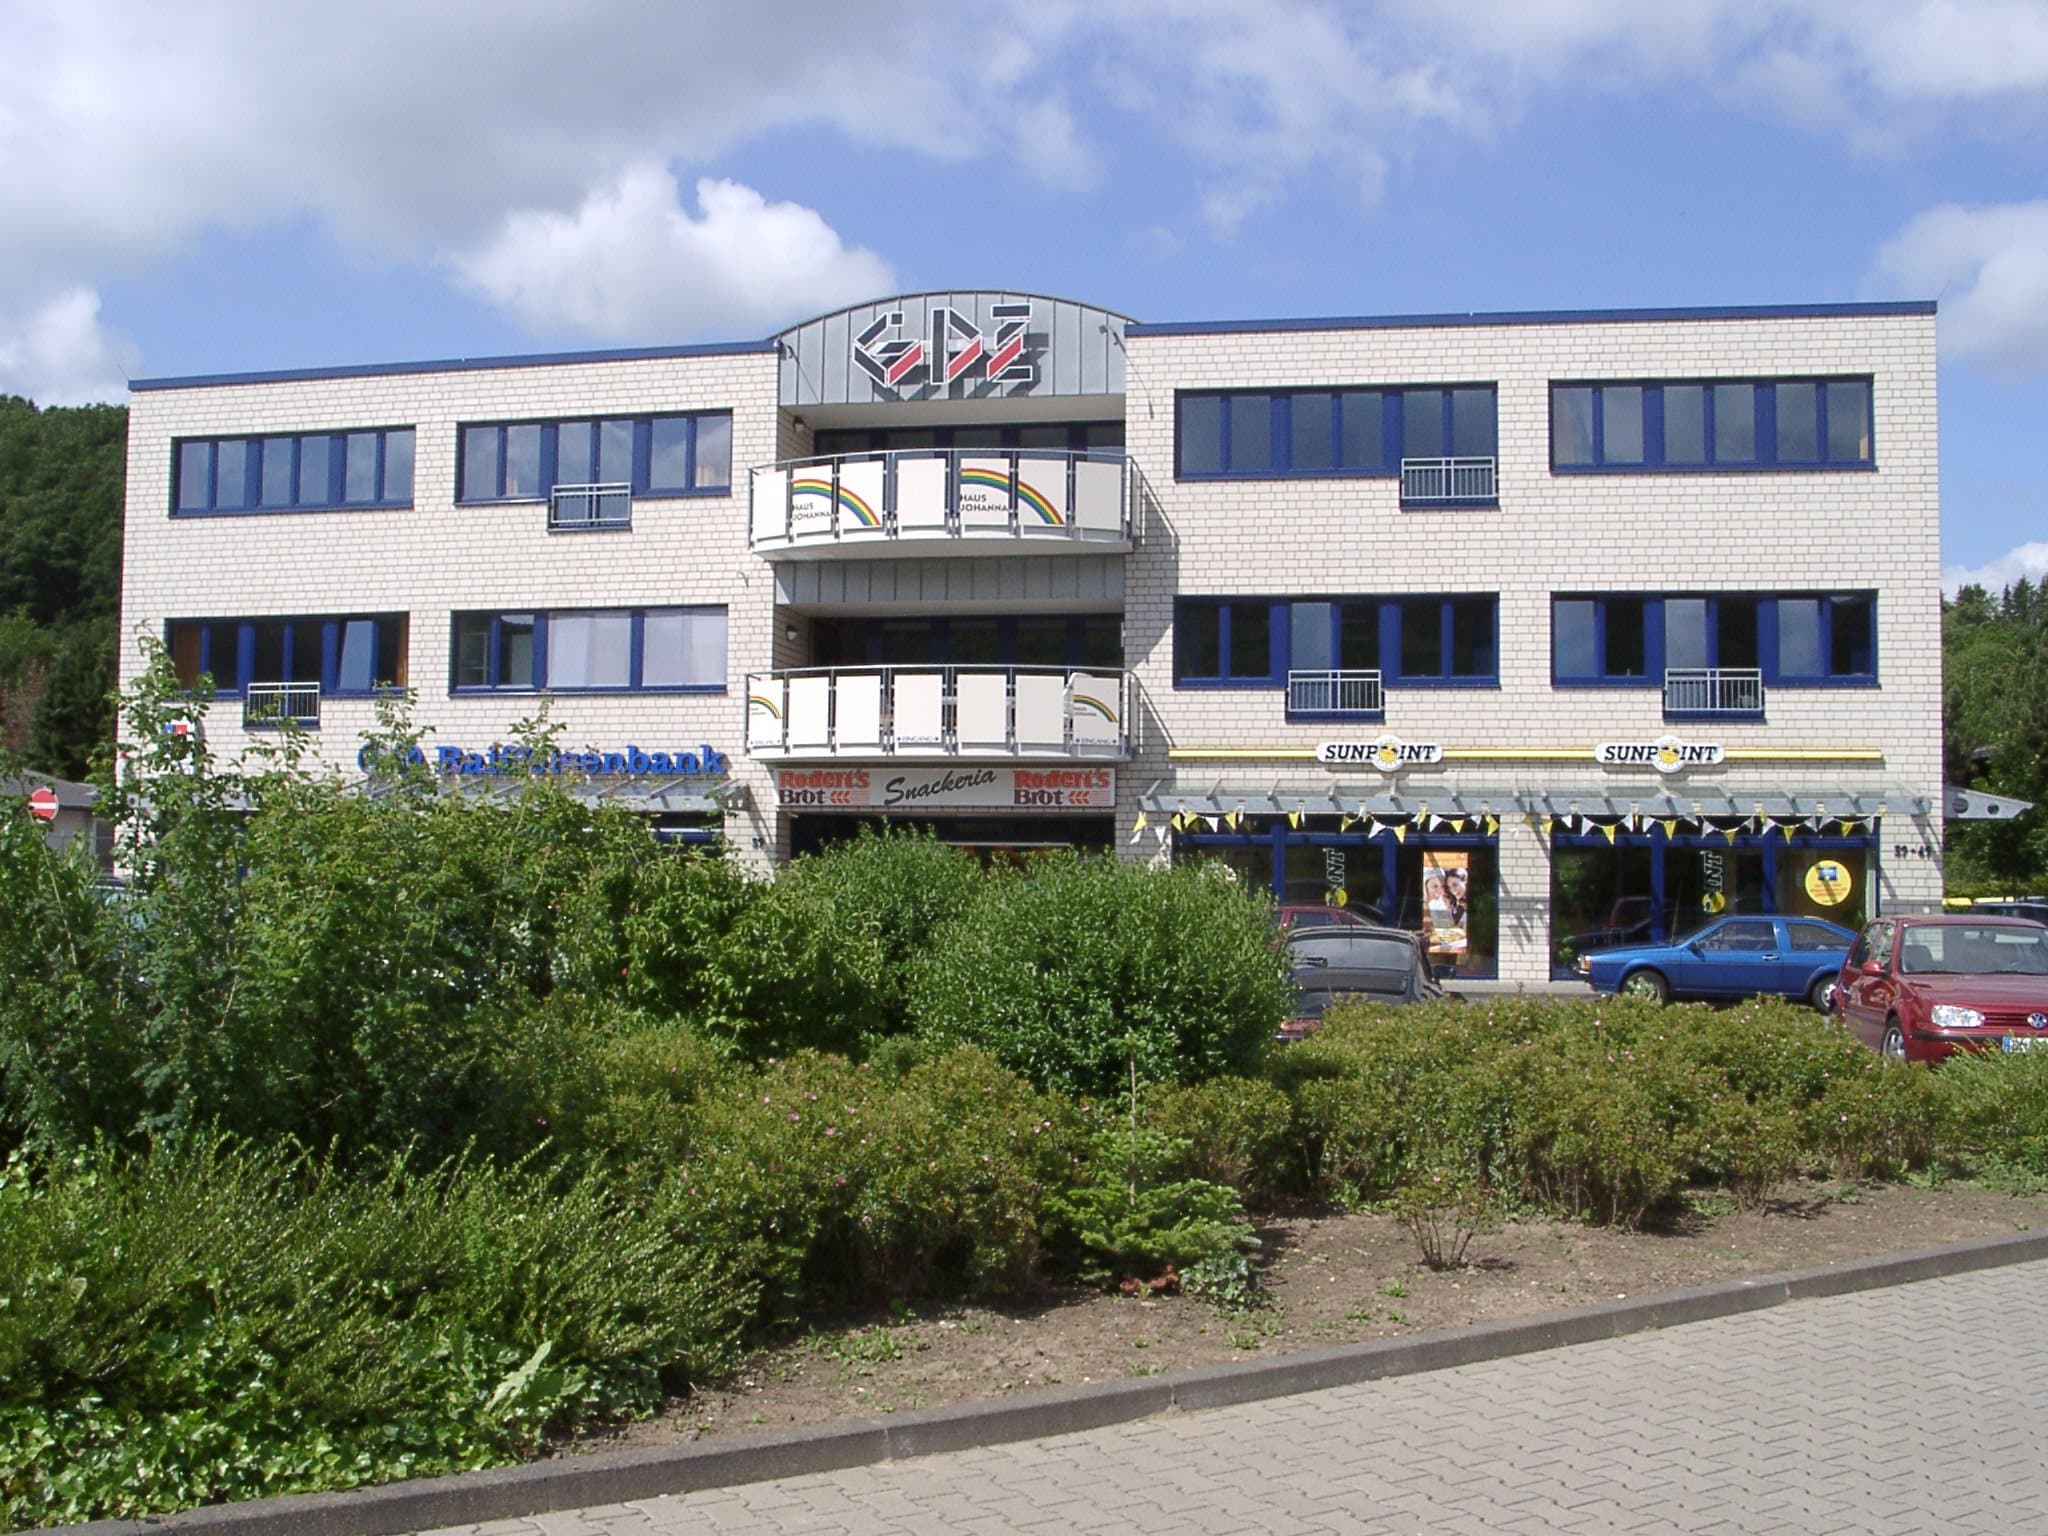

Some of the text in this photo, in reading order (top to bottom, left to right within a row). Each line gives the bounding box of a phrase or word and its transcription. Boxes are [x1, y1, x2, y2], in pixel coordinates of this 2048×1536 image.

[960, 493, 987, 503] HAUS
[960, 503, 1009, 512] JOHANNA
[884, 769, 998, 805] Snackeria
[779, 789, 826, 804] Brot
[1014, 789, 1064, 805] Brot
